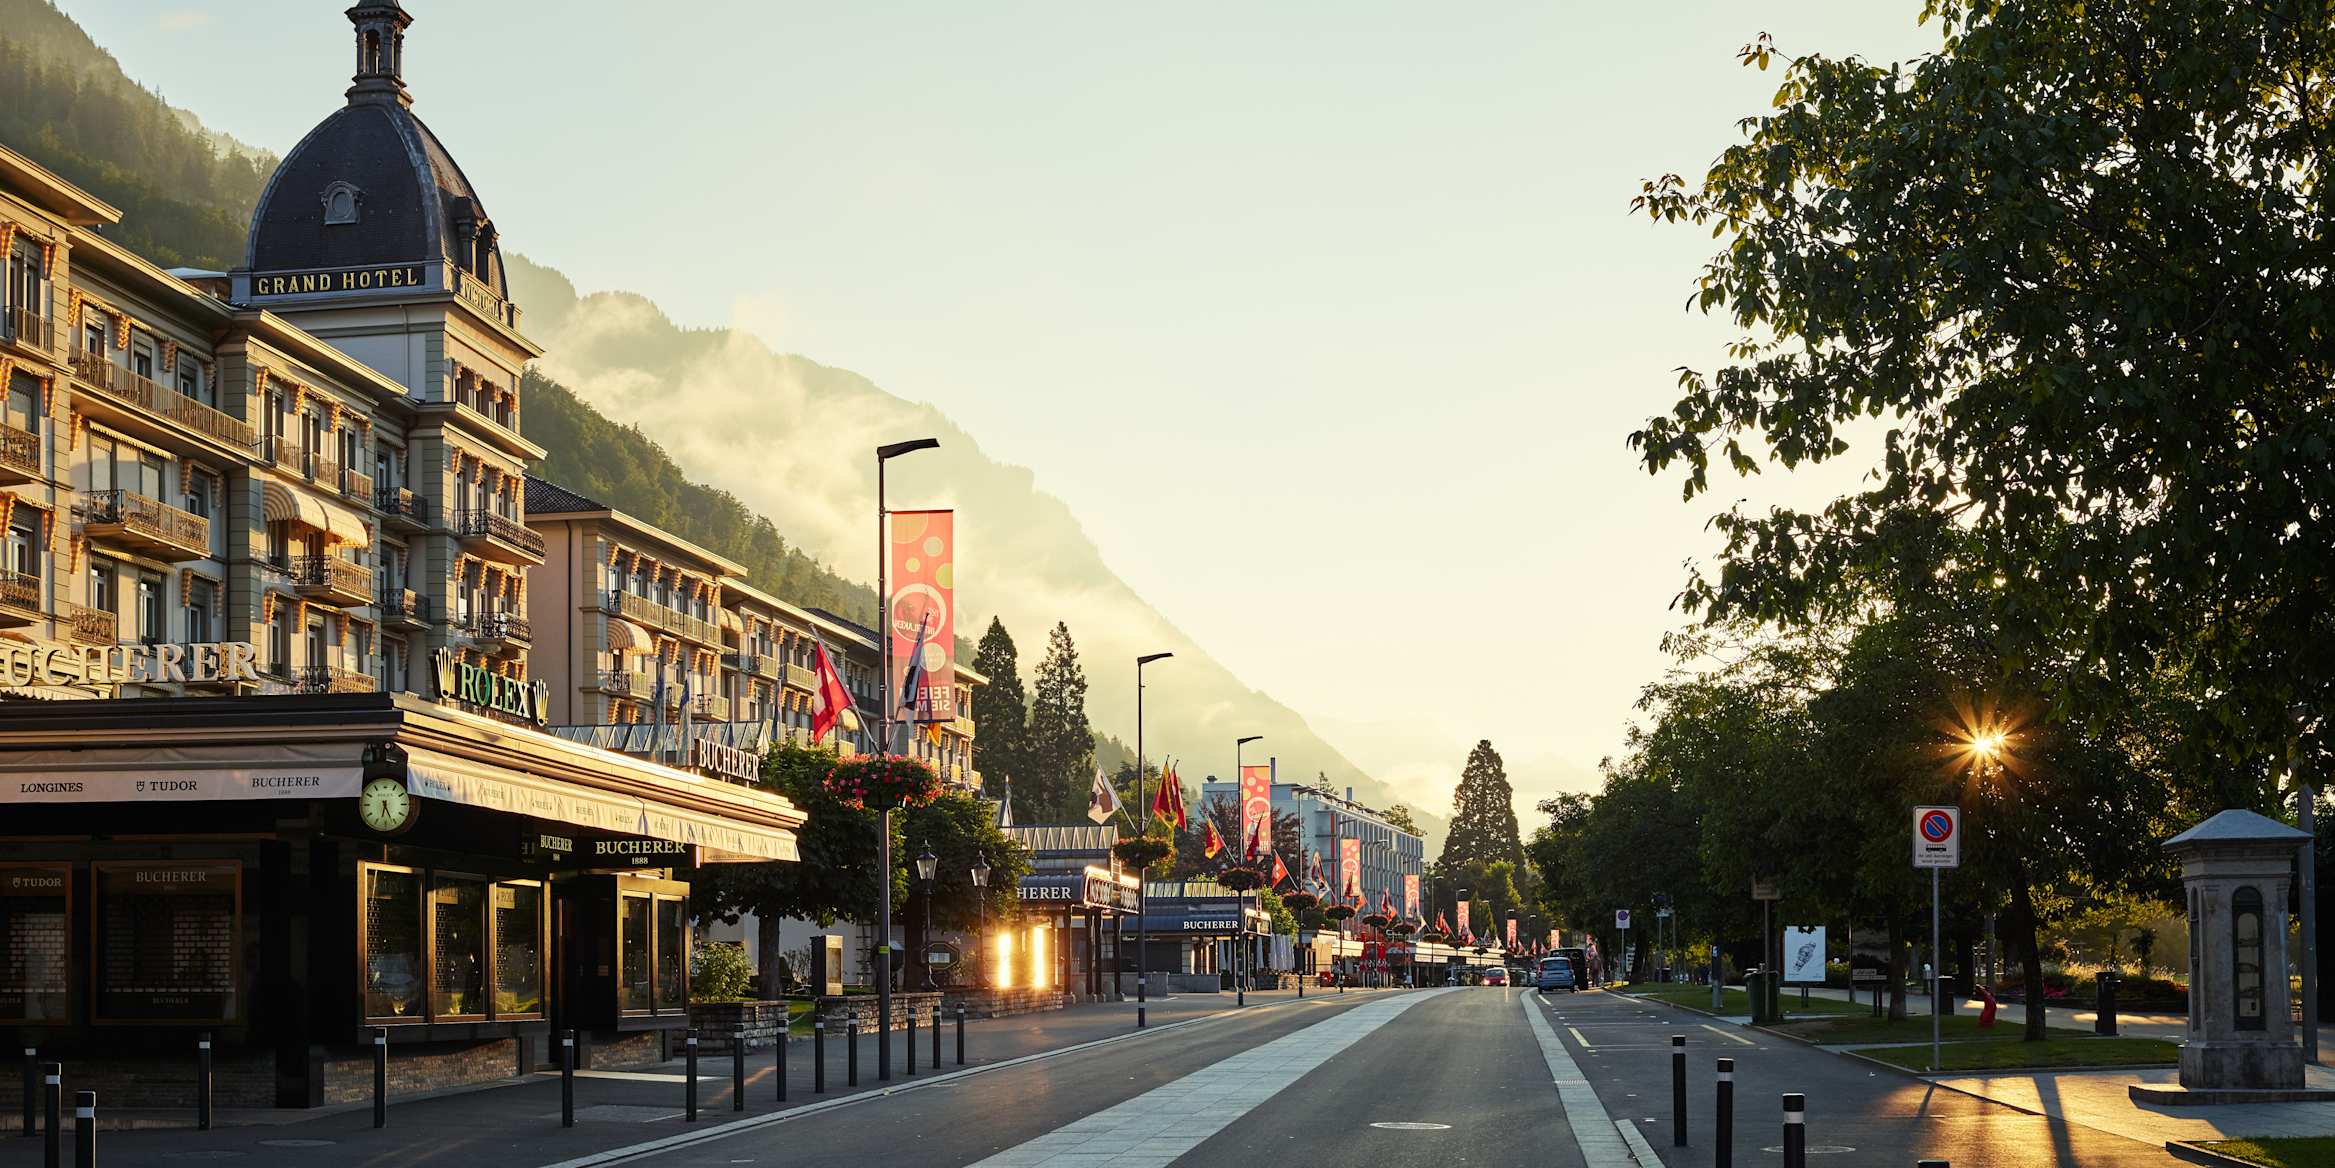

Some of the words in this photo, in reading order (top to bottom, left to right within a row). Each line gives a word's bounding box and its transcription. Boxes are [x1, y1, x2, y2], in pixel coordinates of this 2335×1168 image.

[258, 273, 331, 294] GRAND
[342, 268, 418, 289] HOTEL
[0, 642, 260, 687] UCHERER
[459, 662, 531, 719] ROLEX
[698, 738, 761, 783] BUCHERER
[20, 782, 84, 793] LONGINES
[150, 780, 198, 791] TUDOR
[251, 776, 320, 788] BUCHERER
[540, 834, 573, 852] BUCHERER
[595, 840, 686, 855] BUCHERER
[631, 857, 649, 865] 1888
[22, 877, 62, 887] TUDOR
[135, 871, 207, 882] BUCHERER
[1016, 886, 1072, 900] HERER
[1183, 920, 1239, 930] BUCHERER
